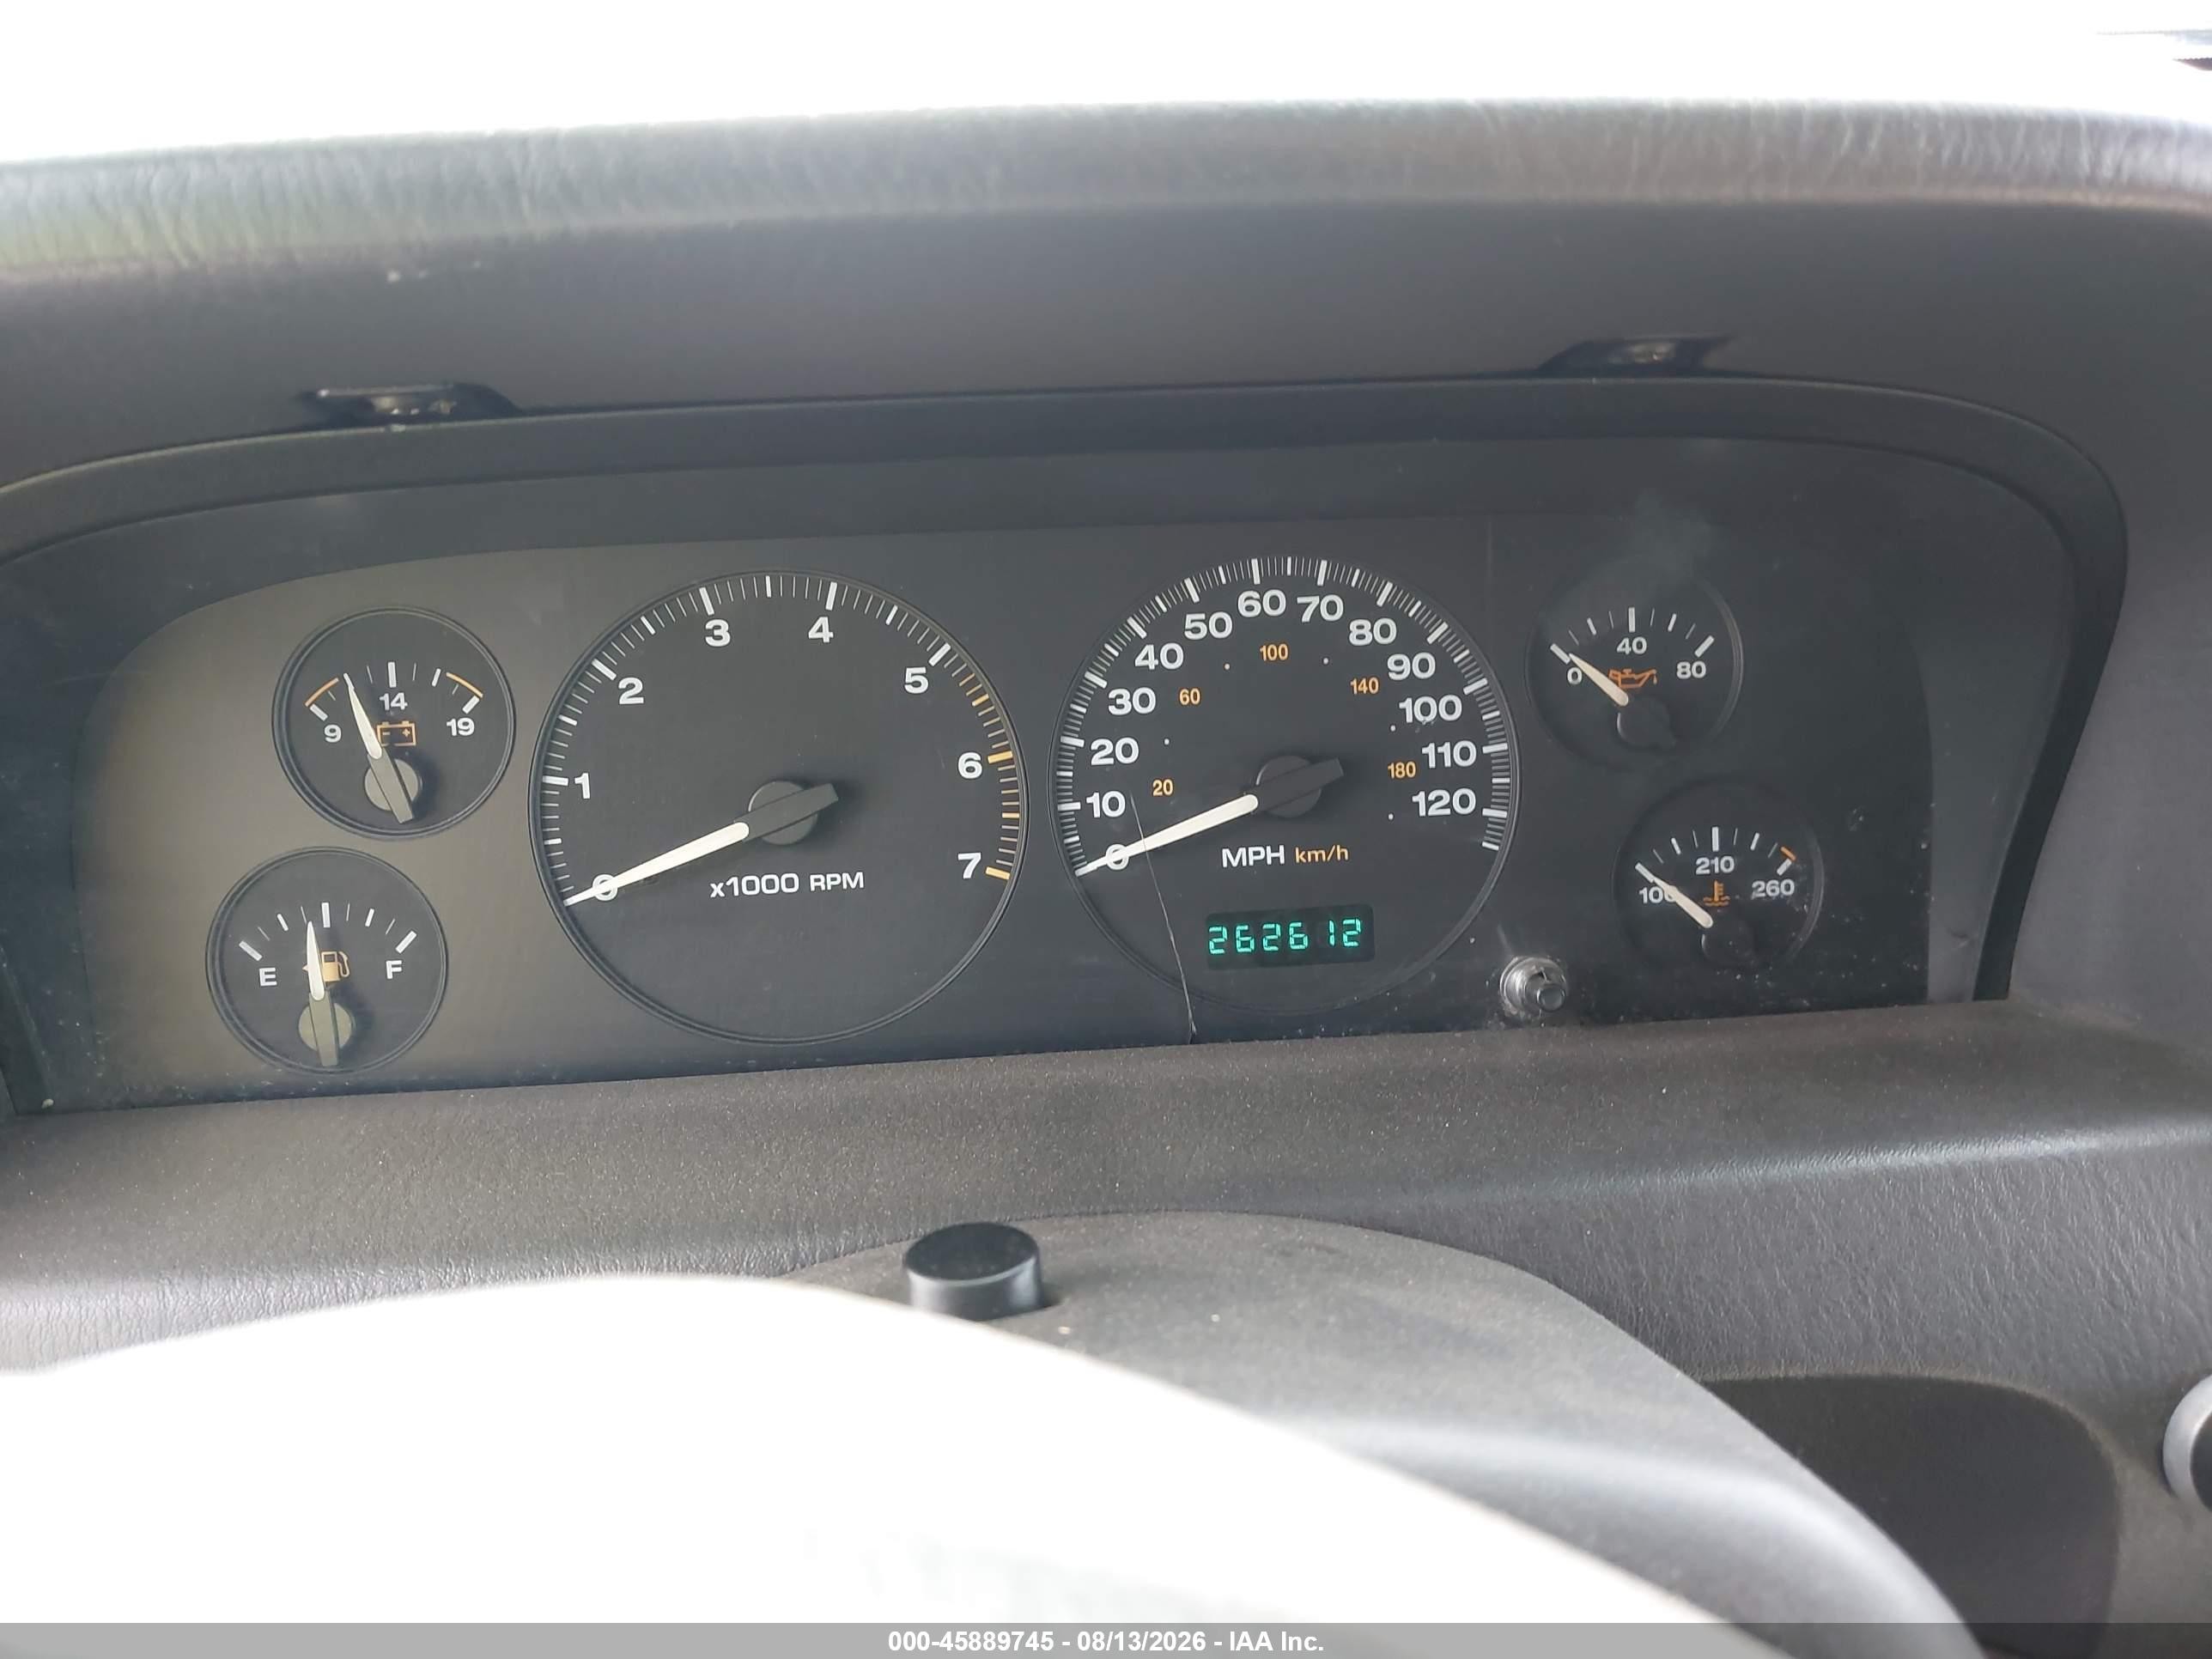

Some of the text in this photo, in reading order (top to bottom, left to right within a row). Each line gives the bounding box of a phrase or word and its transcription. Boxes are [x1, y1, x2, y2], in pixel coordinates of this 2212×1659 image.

[1237, 590, 1286, 617] 60
[1297, 595, 1344, 623] 70
[705, 619, 731, 647] 3
[808, 617, 834, 642] 4
[1185, 611, 1232, 640] 50
[1348, 617, 1397, 646] 80
[1134, 643, 1184, 670] 40
[1260, 644, 1288, 661] 100
[1616, 637, 1647, 654] 40
[1387, 653, 1436, 680] 90
[1567, 668, 1582, 685] 0
[1676, 661, 1706, 679] 80
[618, 677, 645, 705] 2
[905, 667, 928, 694] 5
[1351, 678, 1379, 695] 140
[380, 692, 407, 711] 14
[1108, 688, 1156, 714] 30
[1179, 688, 1200, 706] 60
[1399, 695, 1462, 722] 100
[325, 725, 341, 743] 9
[447, 718, 475, 737] 19
[1090, 738, 1139, 765] 20
[1422, 741, 1477, 768] 110
[957, 752, 983, 779] 6
[1388, 761, 1416, 779] 180
[574, 773, 591, 799] 1
[1152, 779, 1173, 797] 20
[1086, 791, 1126, 818] 10
[1412, 788, 1476, 817] 120
[957, 853, 981, 879] 7
[1106, 843, 1129, 870] 0
[1222, 845, 1349, 868] MPH km/h
[1696, 857, 1735, 874] 210
[592, 875, 618, 902] 0
[710, 872, 865, 898] x1000 RPM
[1752, 879, 1795, 897] 260
[1209, 918, 1361, 955] 262612
[260, 968, 276, 986] E
[386, 961, 402, 978] F
